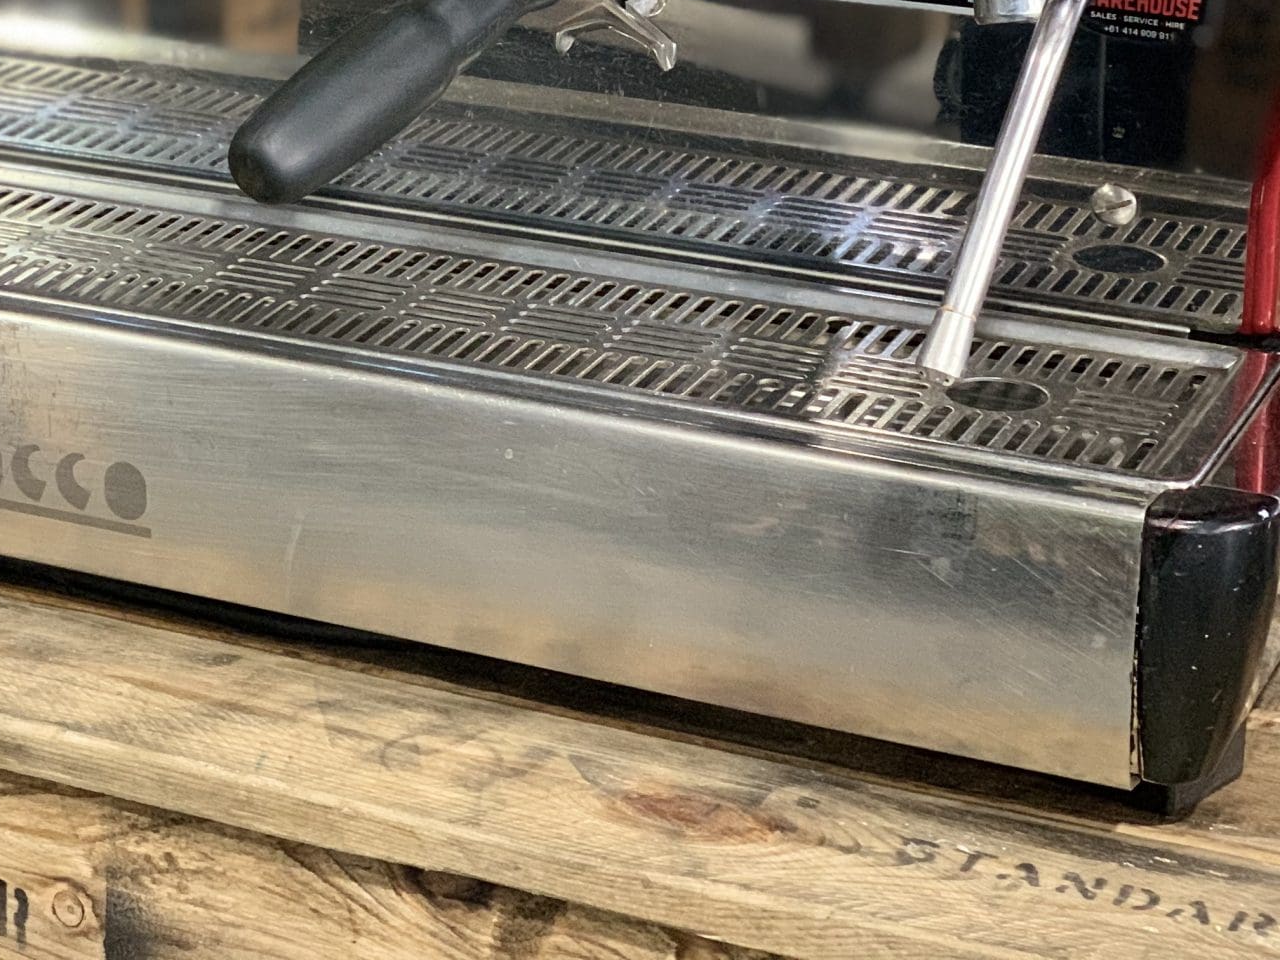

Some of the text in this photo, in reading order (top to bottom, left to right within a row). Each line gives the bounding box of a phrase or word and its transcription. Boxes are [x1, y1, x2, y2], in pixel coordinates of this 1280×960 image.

[1090, 10, 1185, 31] SALES SERVICE HIRE
[1122, 26, 1139, 36] 414
